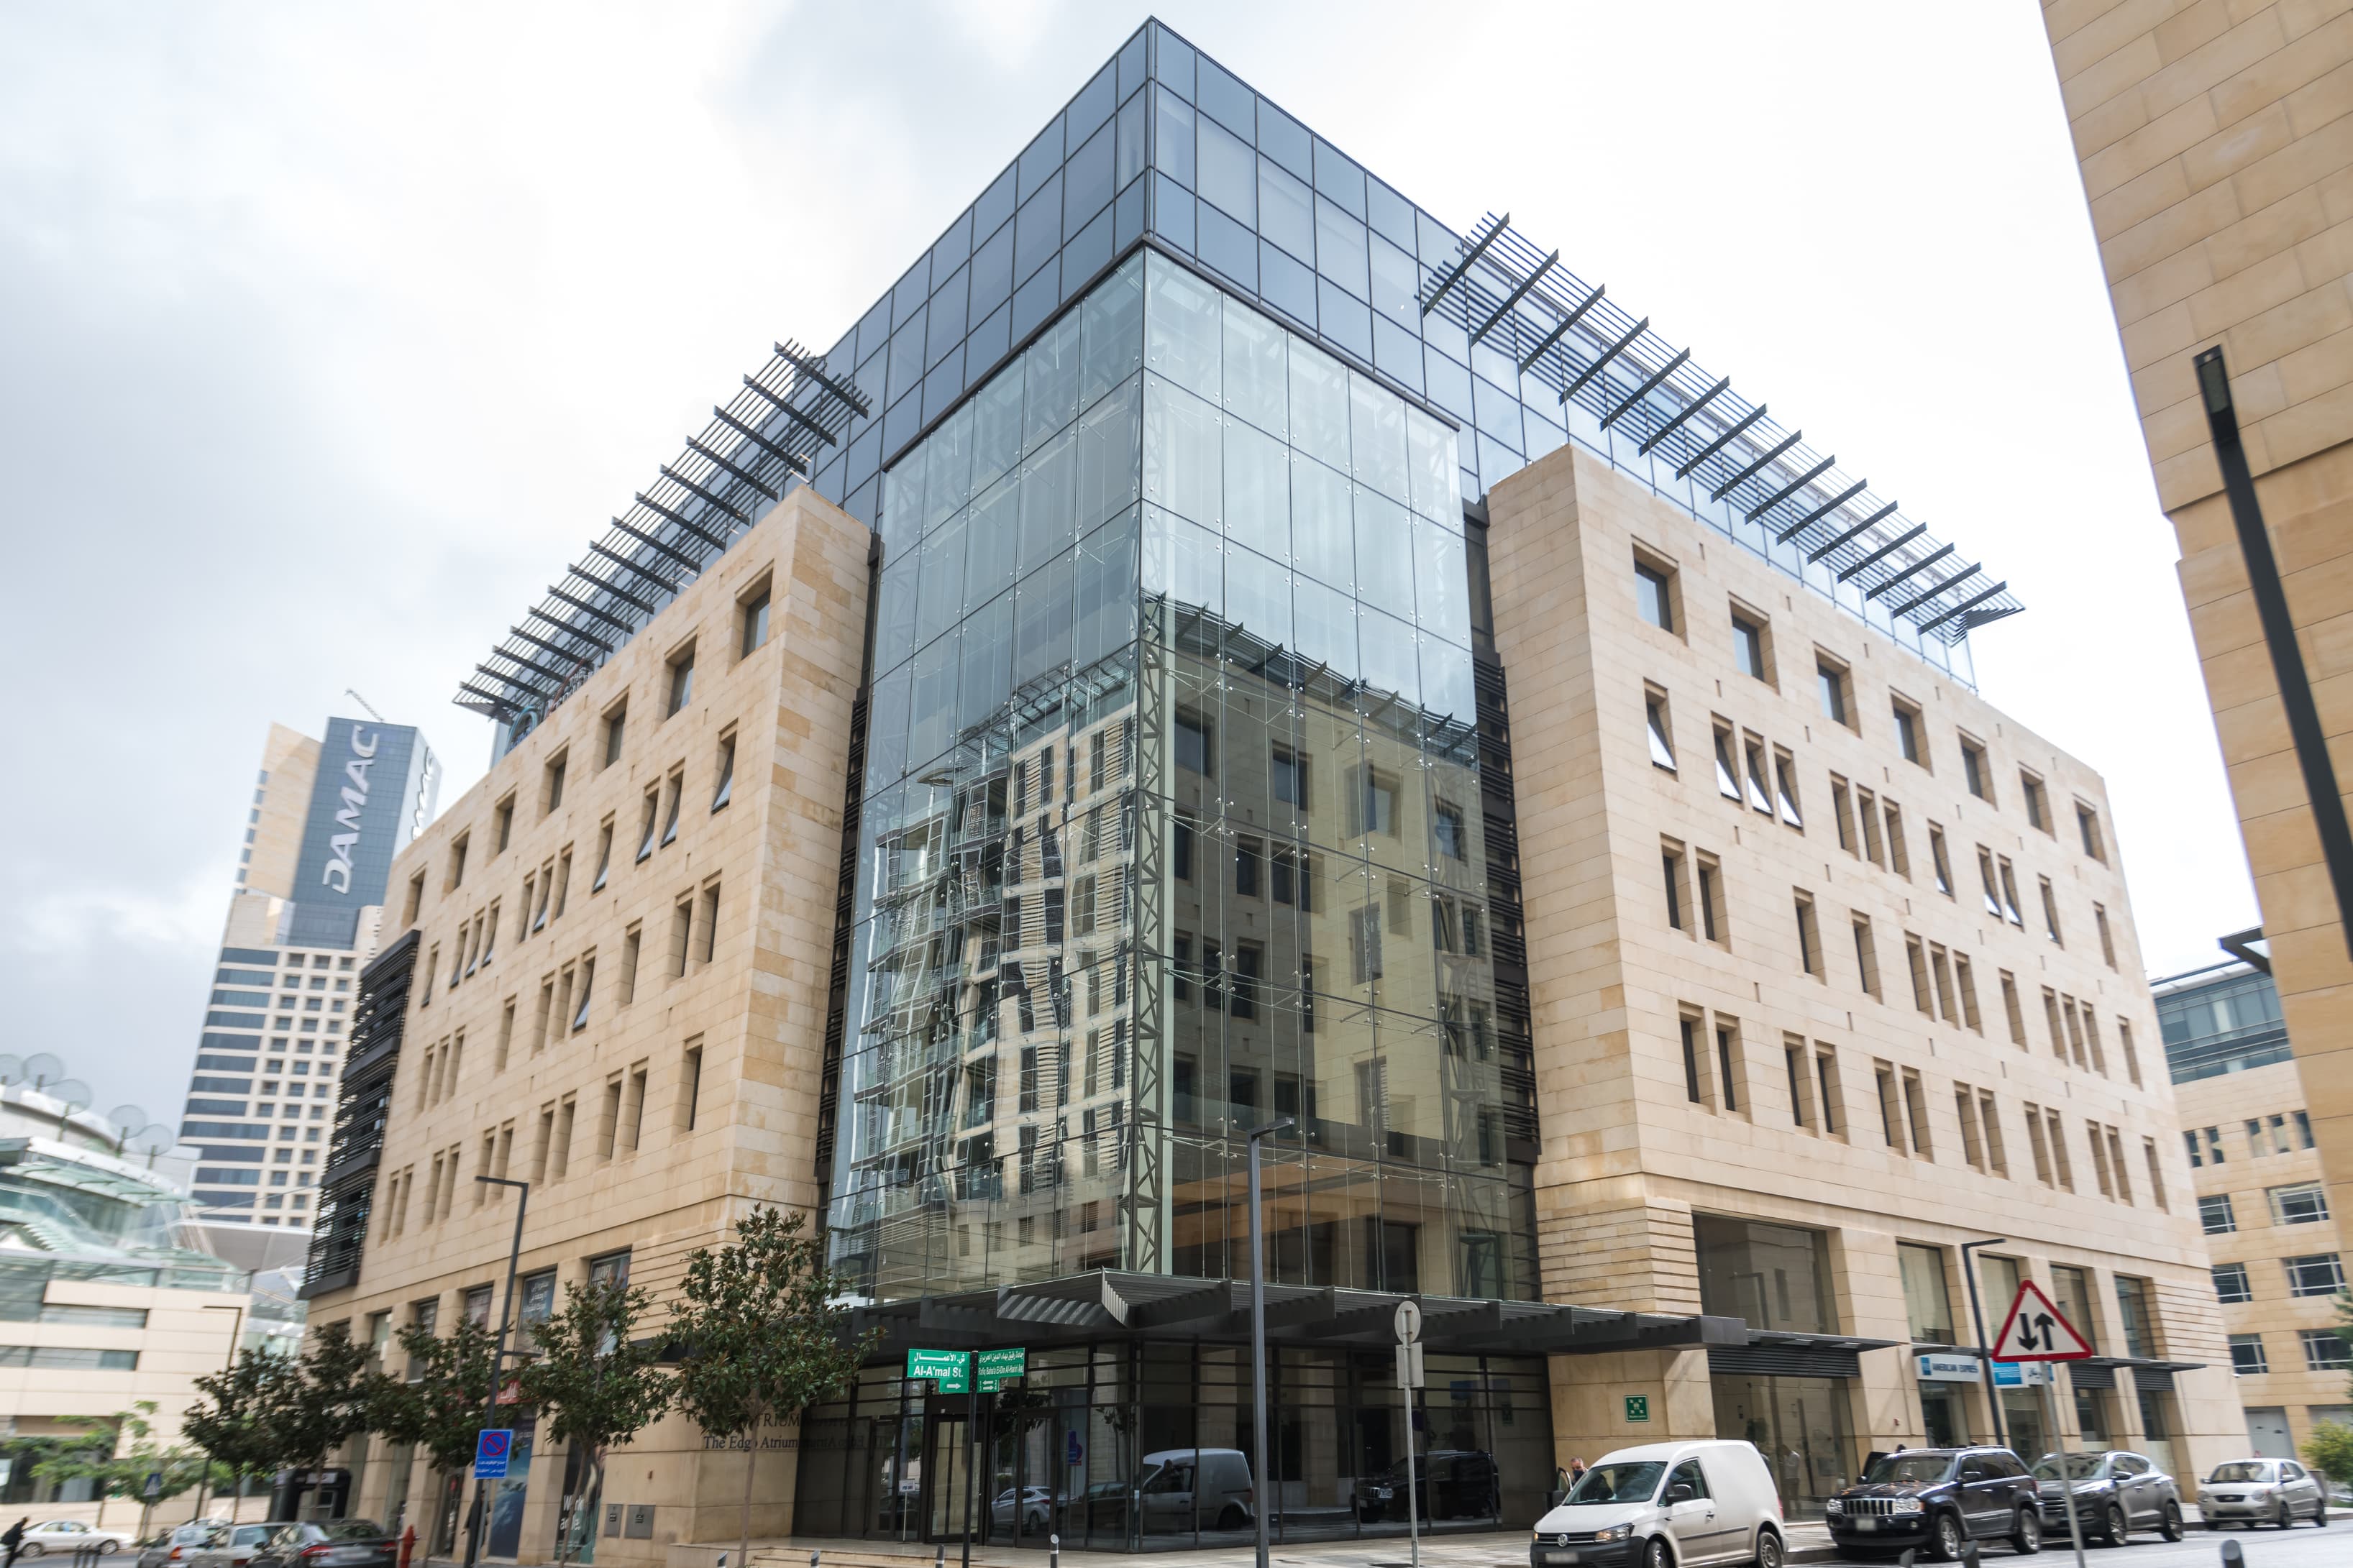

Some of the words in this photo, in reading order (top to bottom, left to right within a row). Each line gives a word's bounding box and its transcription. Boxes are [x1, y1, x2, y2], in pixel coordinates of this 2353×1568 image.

[322, 724, 380, 895] DAMAC
[913, 1365, 951, 1377] Al-A'mal
[952, 1367, 964, 1377] St.
[704, 1435, 726, 1449] The
[729, 1434, 758, 1452] Edg
[760, 1434, 799, 1449] Atrium
[563, 1495, 585, 1511] Wrk
